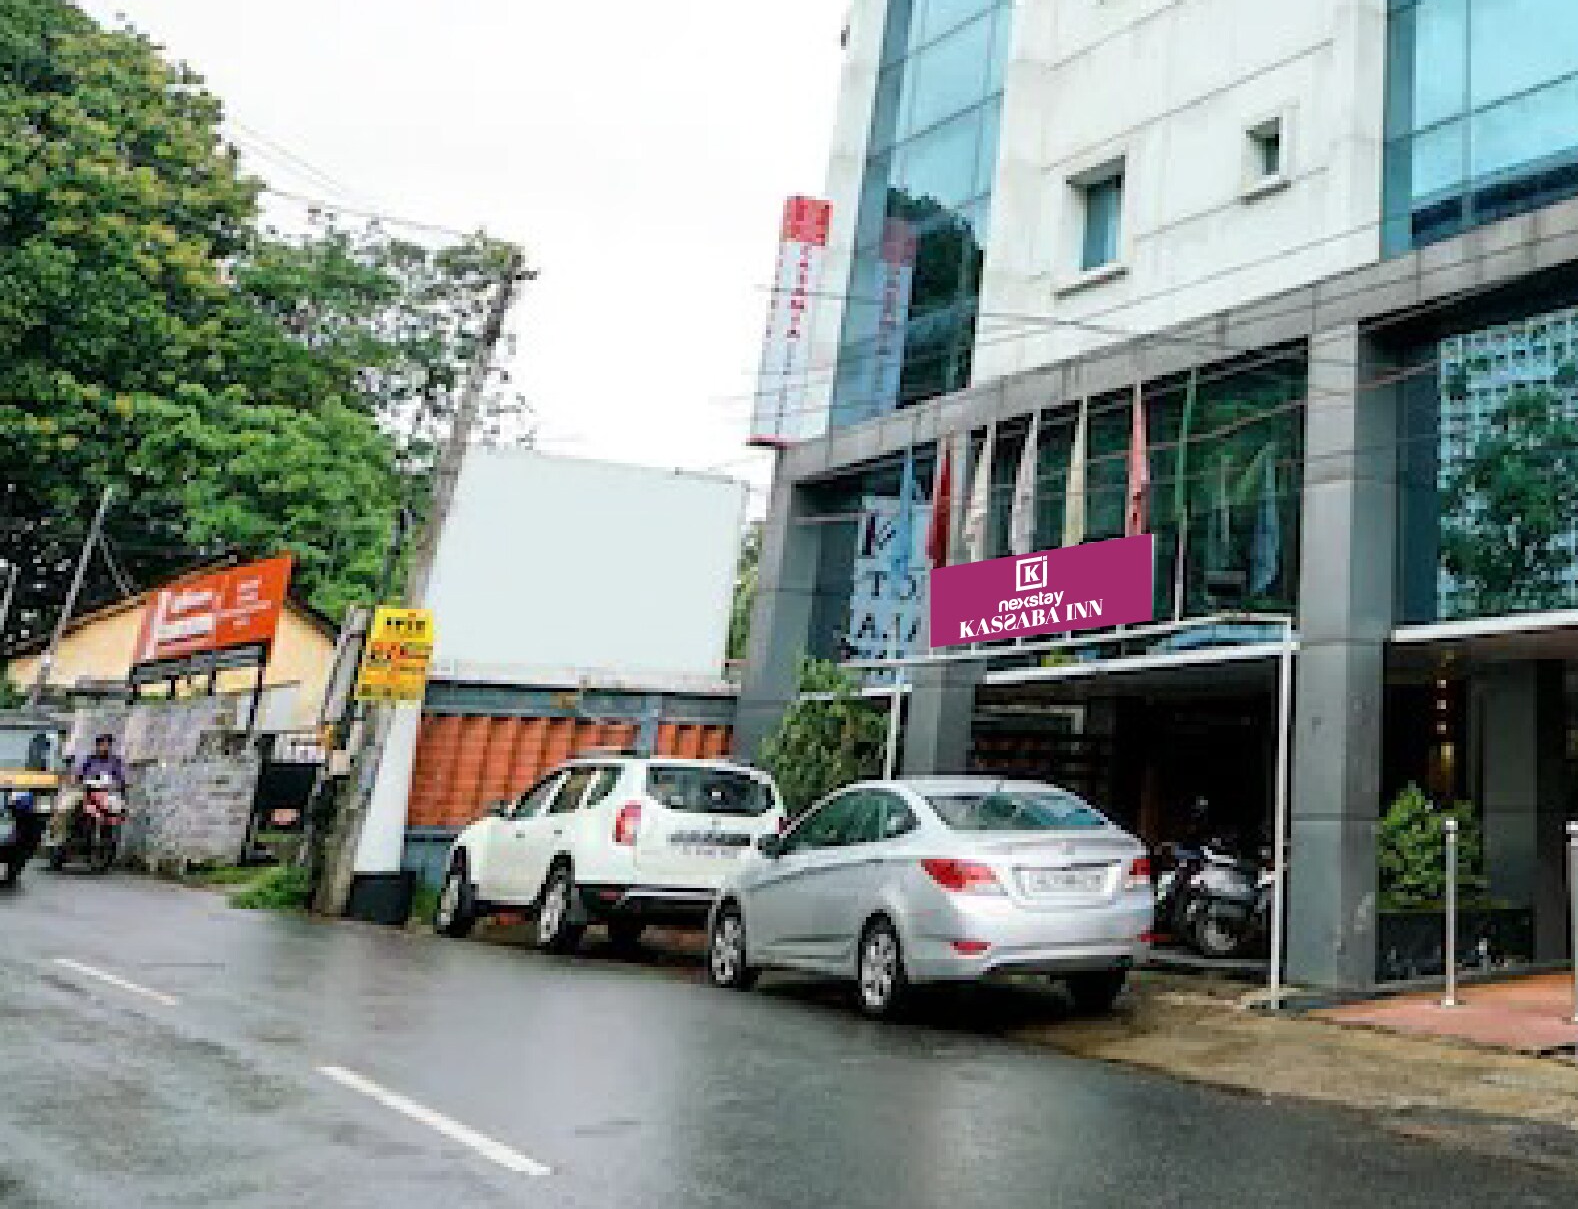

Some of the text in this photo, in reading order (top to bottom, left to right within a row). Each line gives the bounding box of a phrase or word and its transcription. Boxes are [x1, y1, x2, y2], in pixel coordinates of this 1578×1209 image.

[1024, 563, 1041, 583] K
[999, 591, 1064, 612] nexstay
[959, 598, 1104, 638] KASSABA INN
